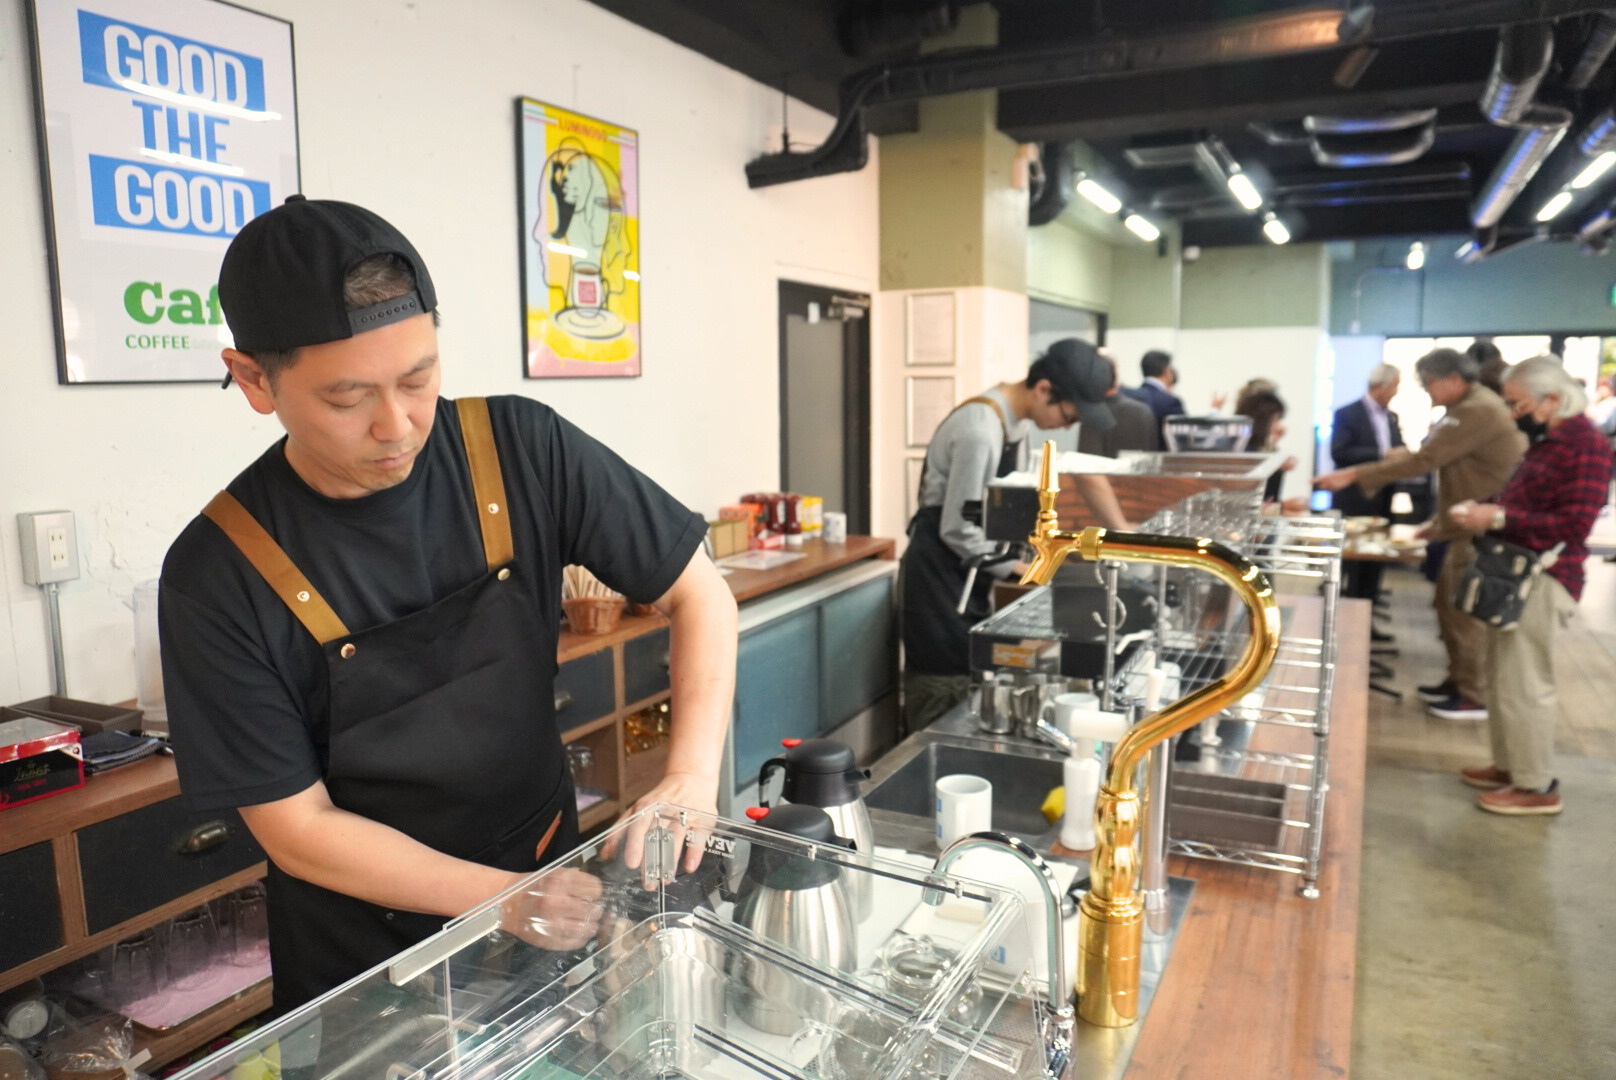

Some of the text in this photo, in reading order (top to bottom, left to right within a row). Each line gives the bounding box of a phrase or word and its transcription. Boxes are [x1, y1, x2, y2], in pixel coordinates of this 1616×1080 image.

[103, 25, 248, 110] GOOD
[131, 99, 234, 167] THE
[114, 165, 254, 235] GOOD
[123, 280, 224, 326] Caf
[125, 334, 190, 350] COFFEE
